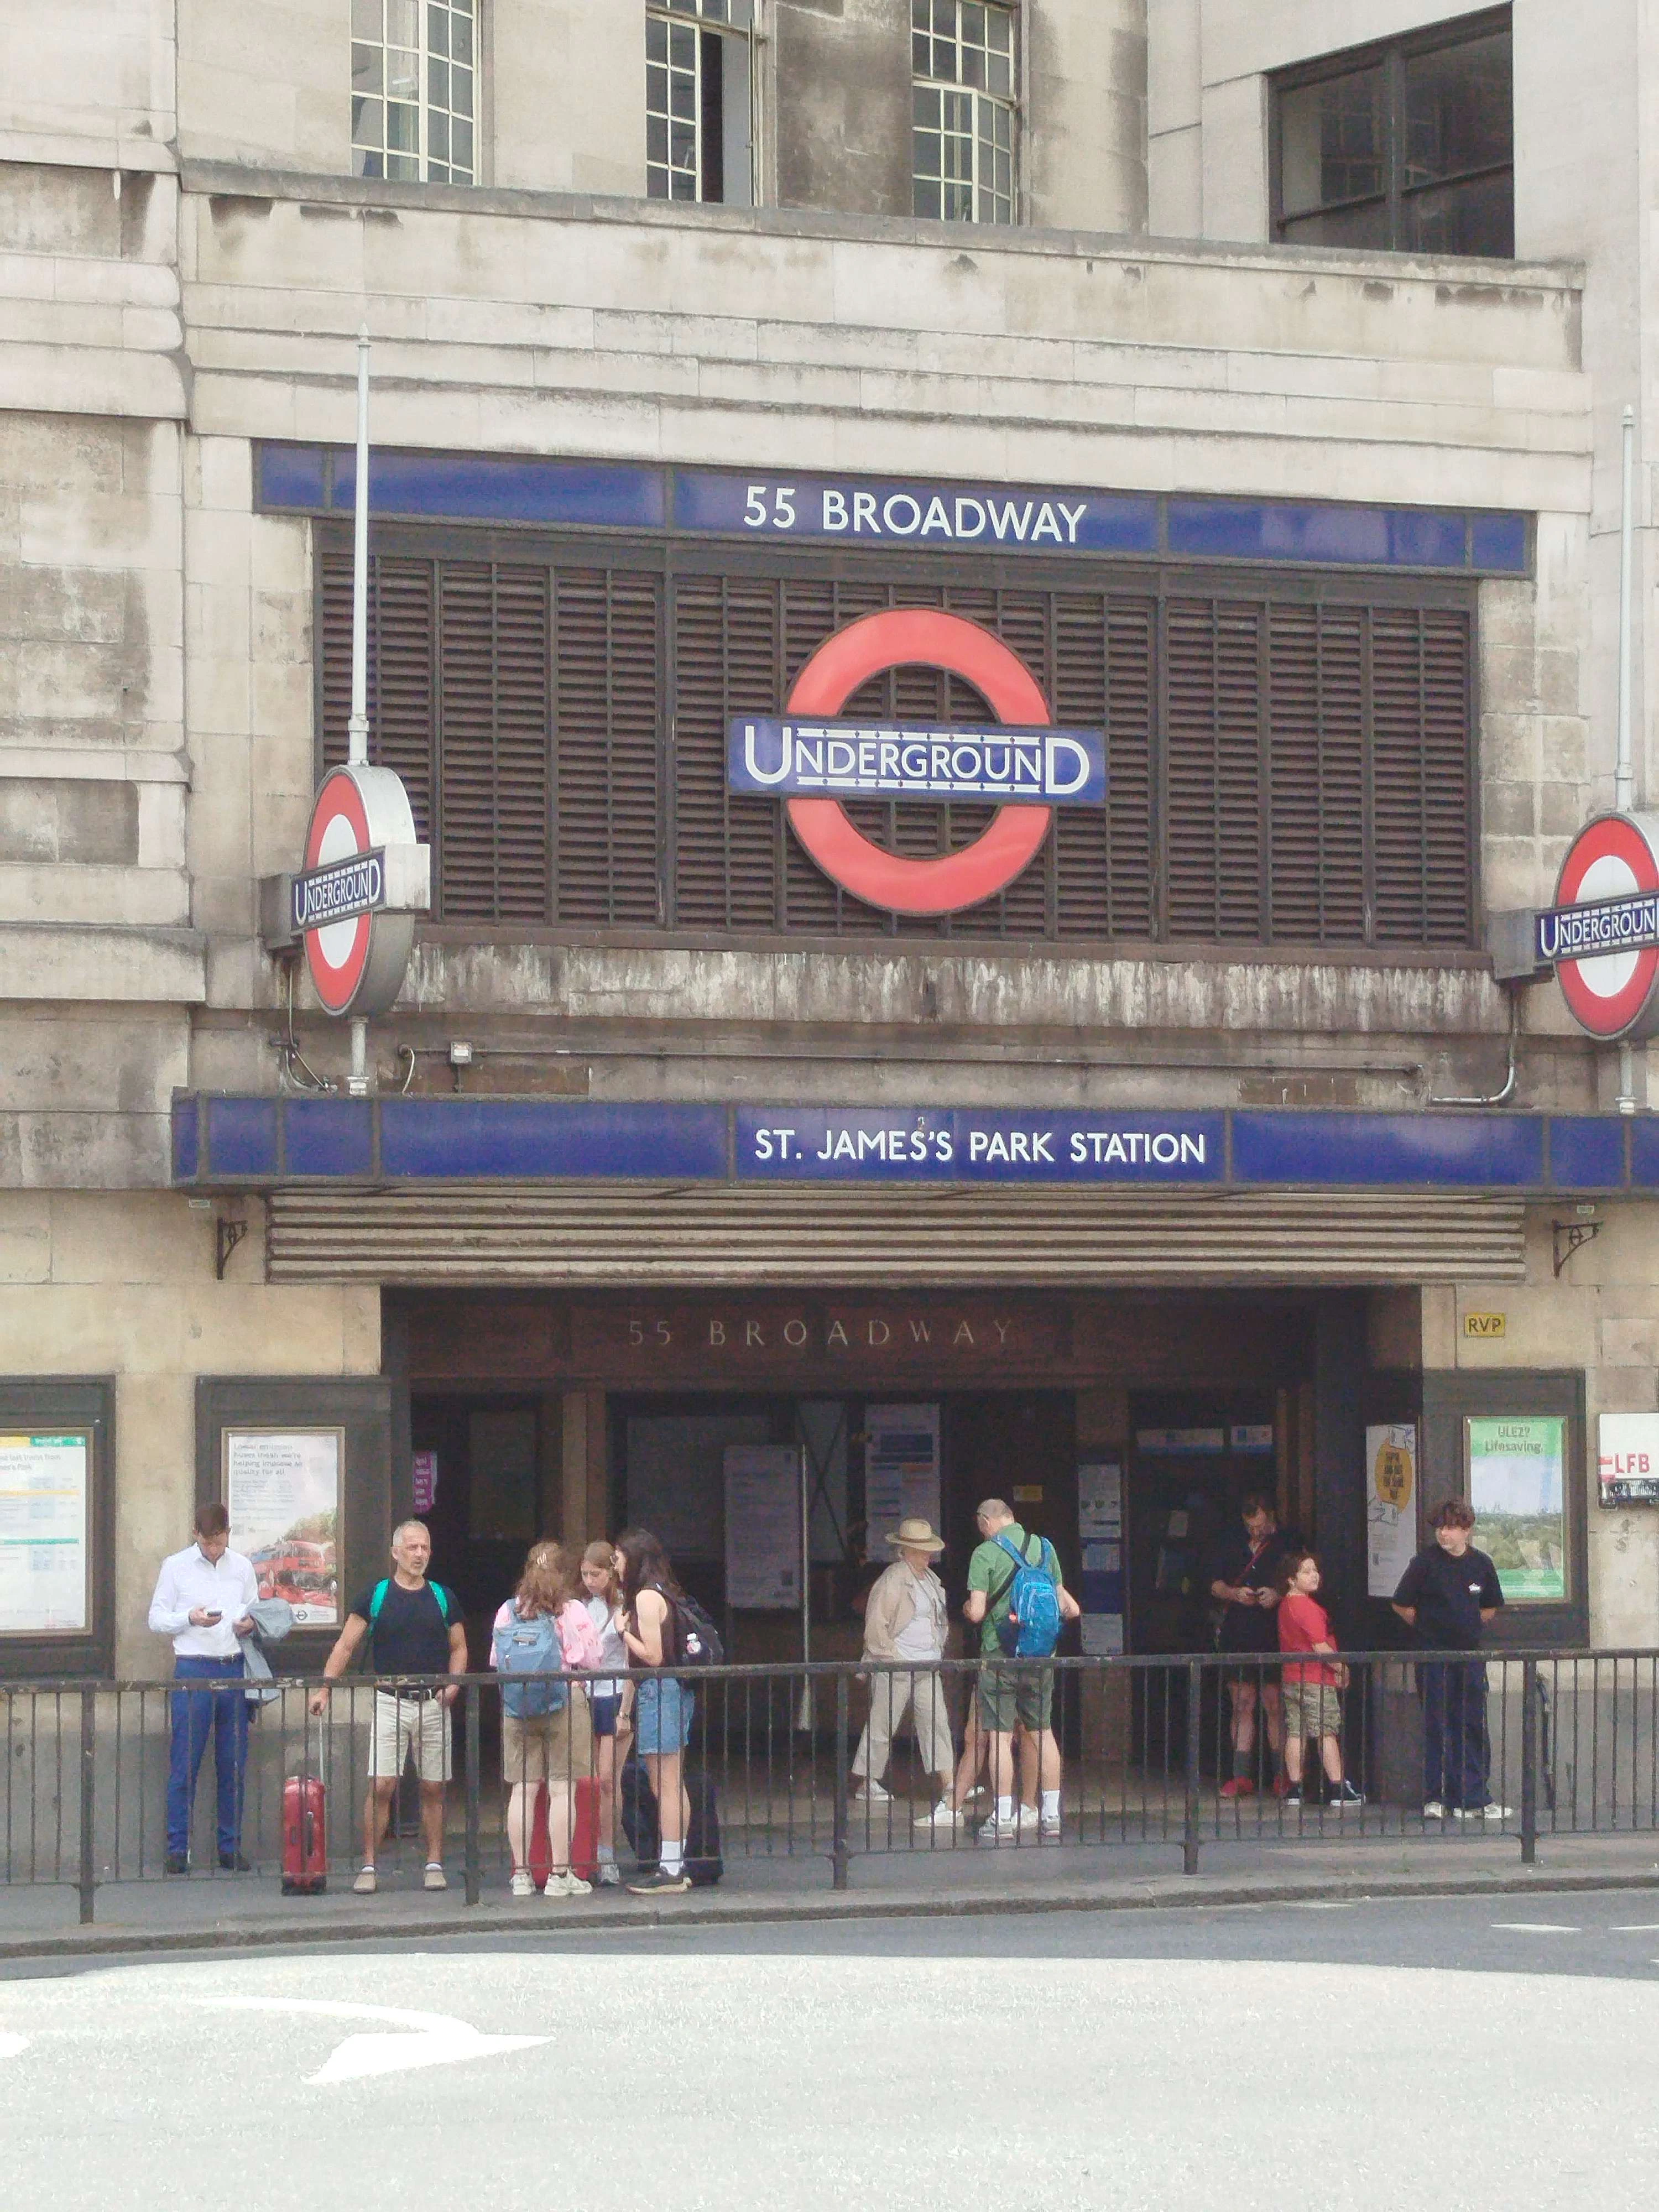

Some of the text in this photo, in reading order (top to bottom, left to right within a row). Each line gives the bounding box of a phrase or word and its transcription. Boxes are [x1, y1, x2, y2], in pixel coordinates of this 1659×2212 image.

[744, 486, 1087, 543] 55 BROADWAY
[744, 725, 1089, 794] UNDERGROUND
[295, 859, 381, 926] UNDERGROUND
[1541, 898, 1659, 957] UNDERGROUN
[755, 1129, 1206, 1164] ST. JAMES'S PARK STATION
[628, 1319, 1012, 1347] 55 BROADWAY
[1468, 1317, 1501, 1332] RVP
[1615, 1453, 1650, 1473] LFB
